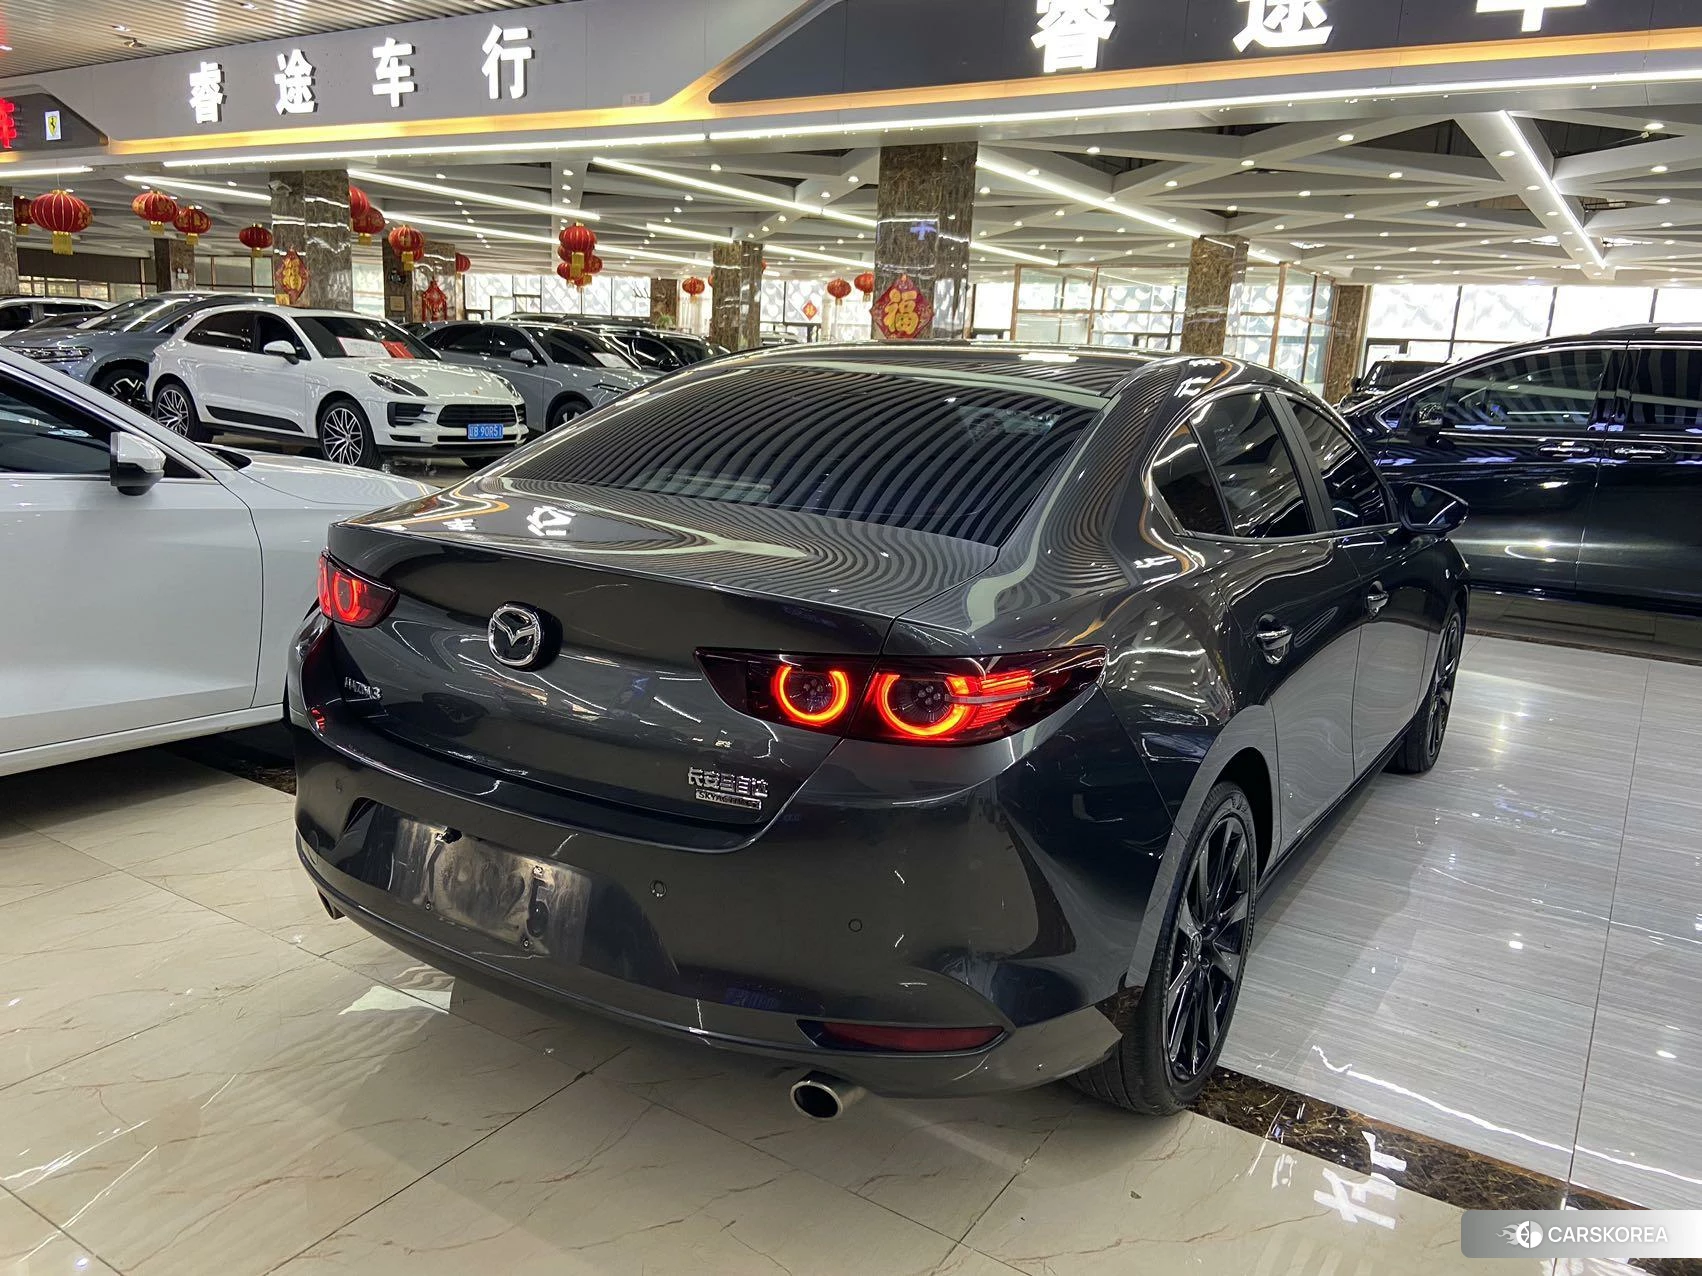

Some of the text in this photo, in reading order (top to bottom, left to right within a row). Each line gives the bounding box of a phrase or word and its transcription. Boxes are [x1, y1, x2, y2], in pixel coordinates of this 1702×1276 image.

[1031, 0, 1589, 73] 睿途
[188, 25, 536, 124] 睿途车行
[883, 288, 919, 335] 福
